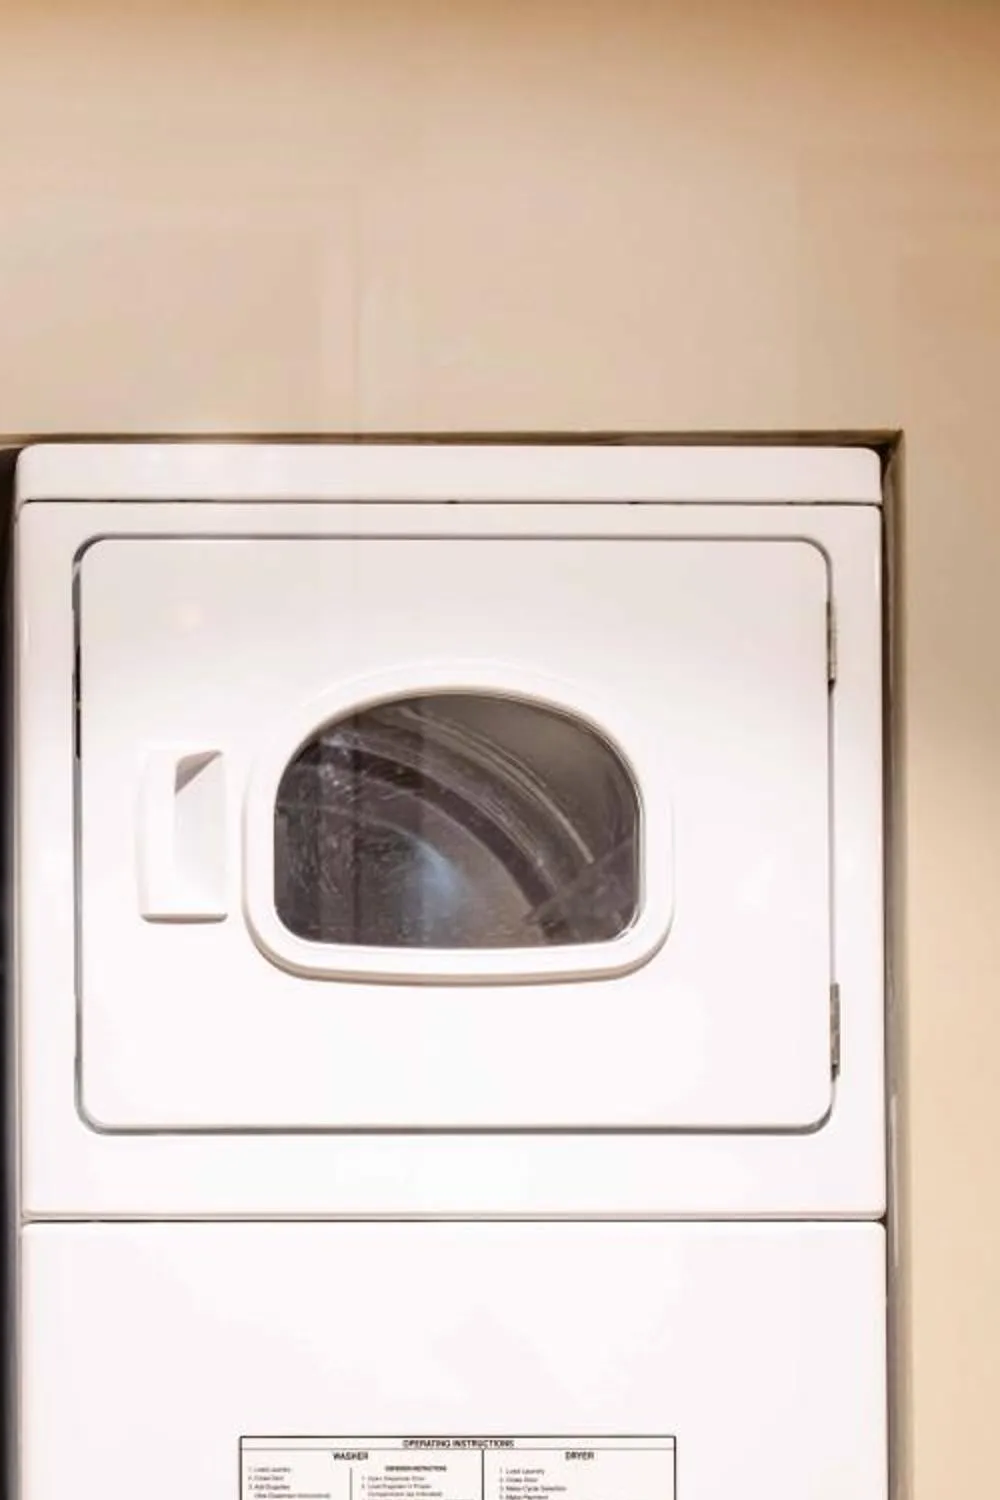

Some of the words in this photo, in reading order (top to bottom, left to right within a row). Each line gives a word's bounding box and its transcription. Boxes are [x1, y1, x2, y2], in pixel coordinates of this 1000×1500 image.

[402, 1440, 451, 1449] OPERATING
[452, 1440, 514, 1449] INSTRUCTIONS
[333, 1452, 369, 1461] WASHER
[565, 1451, 594, 1461] DRYER
